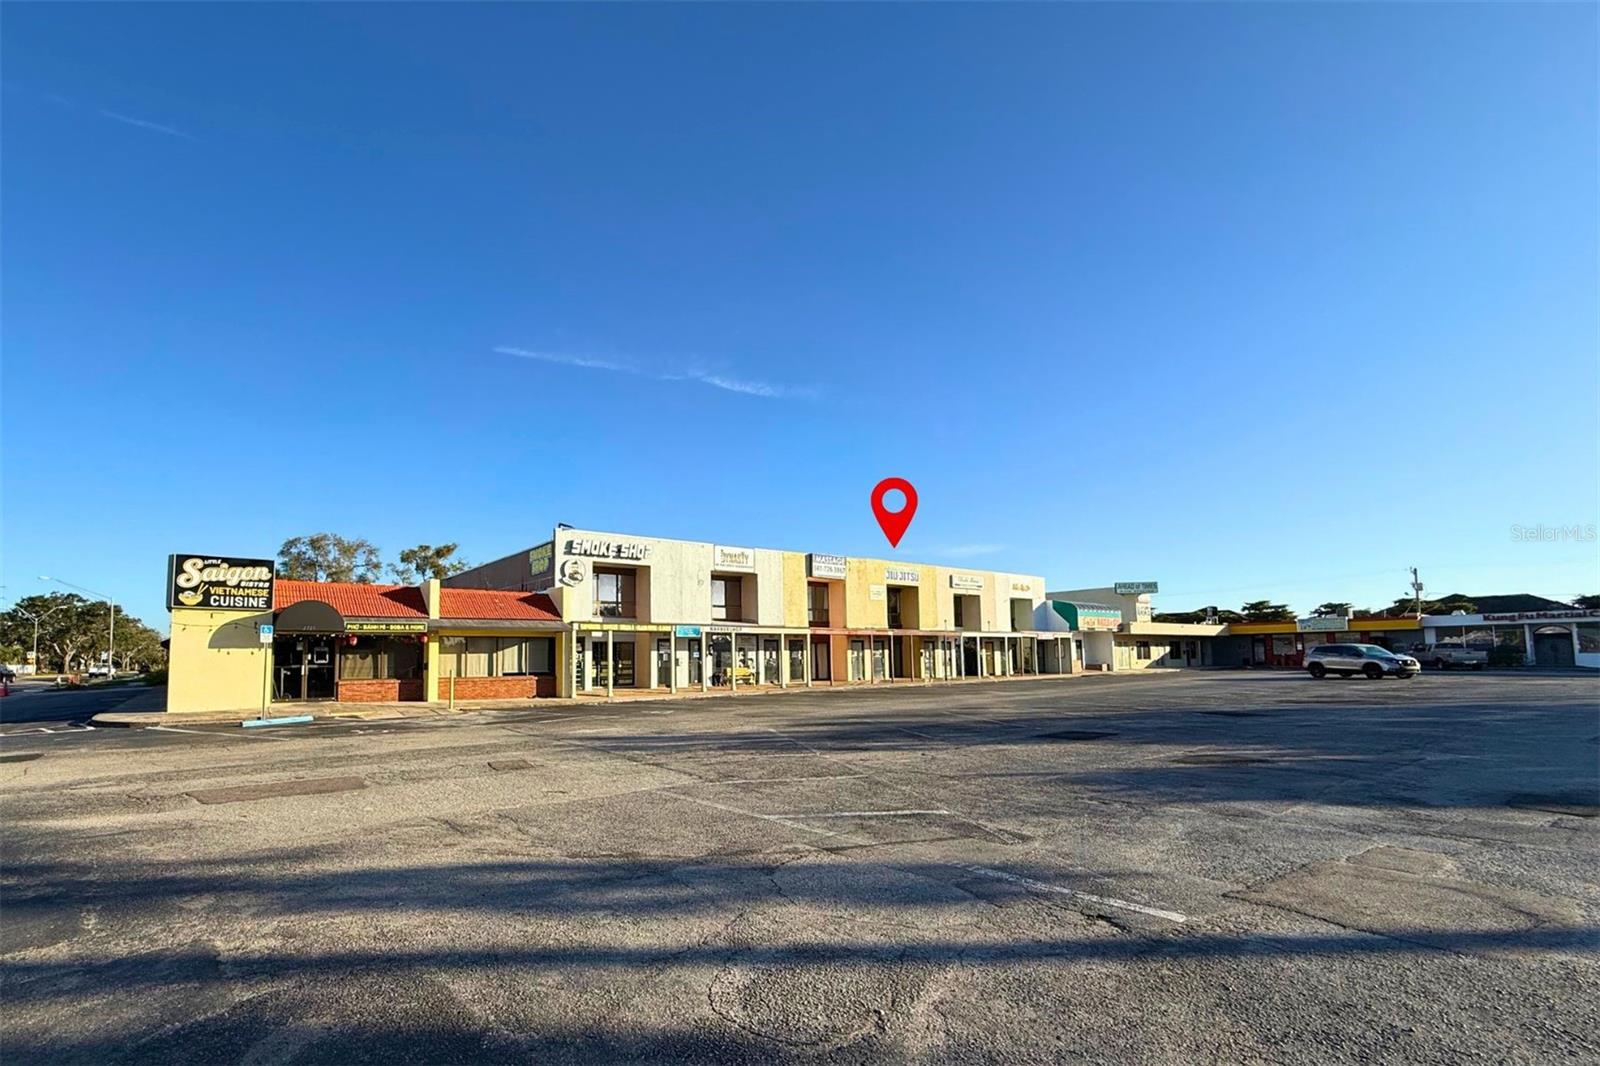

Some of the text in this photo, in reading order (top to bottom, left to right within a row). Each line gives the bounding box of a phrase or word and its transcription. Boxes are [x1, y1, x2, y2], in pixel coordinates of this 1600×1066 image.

[571, 539, 618, 557] SMOKE
[176, 558, 272, 588] Saigon
[209, 586, 270, 597] VIETNAMESE
[209, 595, 268, 608] CUISINE
